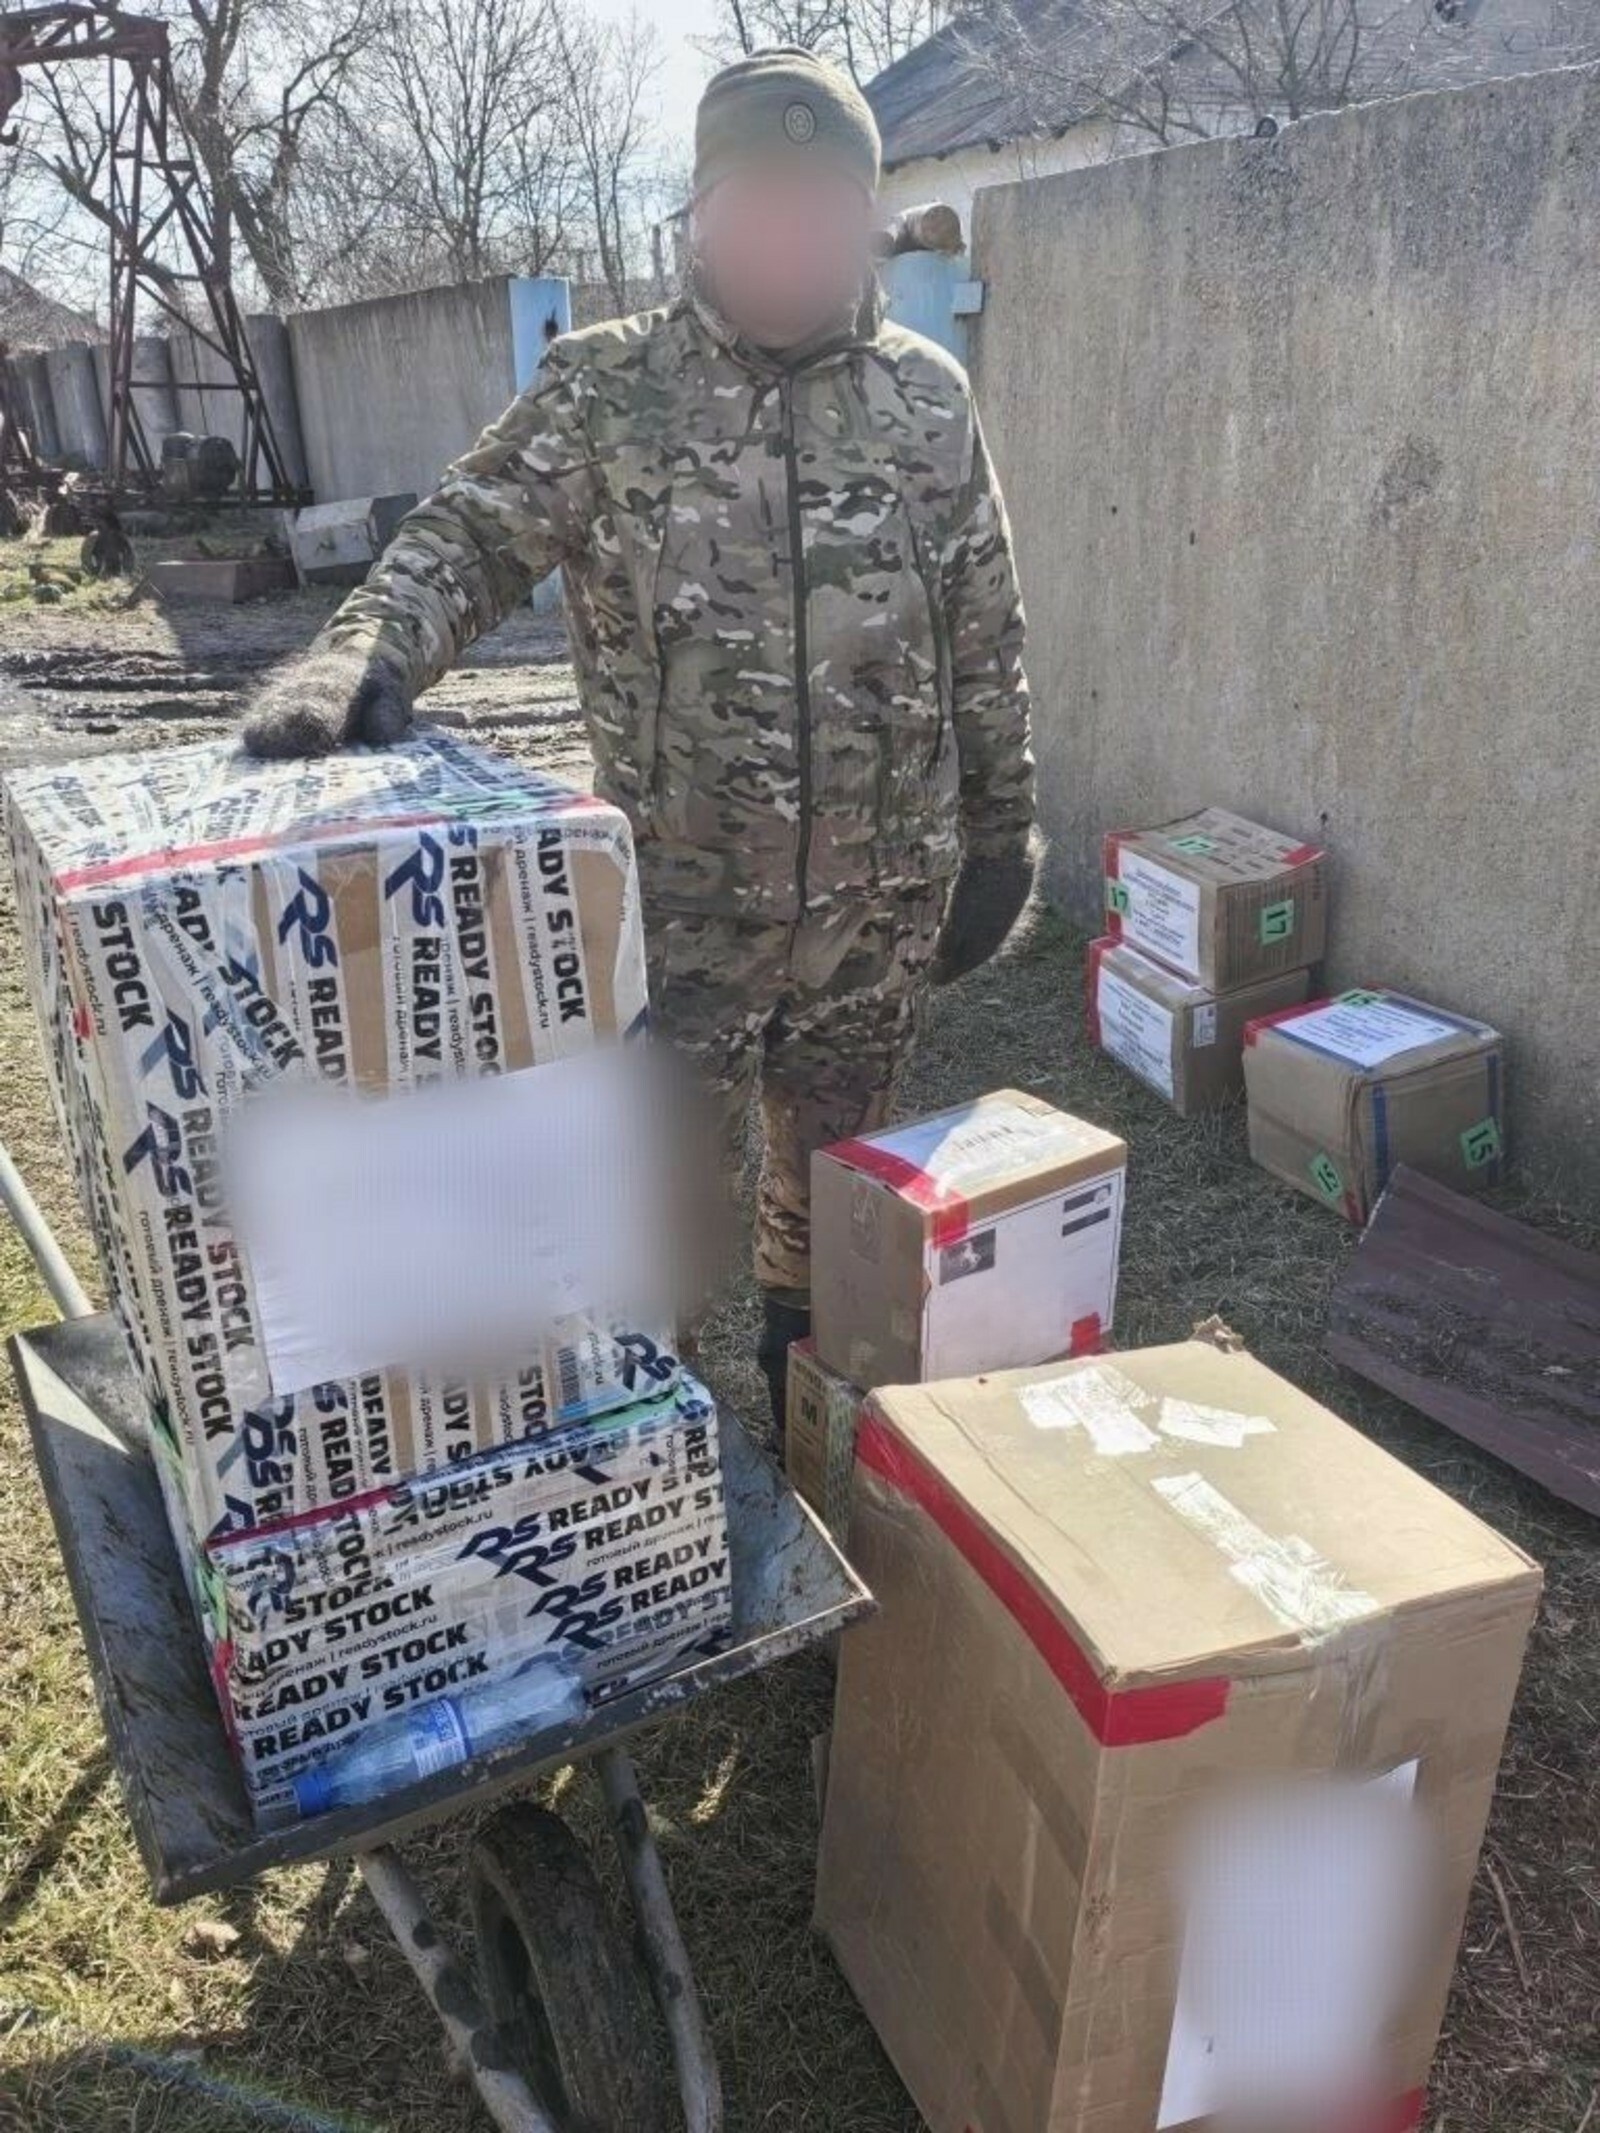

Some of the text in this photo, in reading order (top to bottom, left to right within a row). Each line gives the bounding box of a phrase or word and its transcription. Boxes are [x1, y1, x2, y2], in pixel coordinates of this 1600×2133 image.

[385, 830, 445, 928] RS
[450, 855, 491, 980] READY
[1265, 909, 1288, 935] 17
[92, 901, 155, 1032] STOCK
[412, 936, 442, 1061] READY
[526, 924, 550, 1029] readystock.ru
[307, 976, 348, 1080] READ
[1468, 1128, 1493, 1162] 15
[163, 1204, 213, 1321] READY
[186, 1332, 234, 1442] STOCK
[517, 1365, 549, 1437] STOC
[319, 1416, 357, 1500] READ
[494, 1530, 578, 1587] RS
[584, 1496, 684, 1551] READY
[548, 1478, 652, 1531] READY
[543, 1595, 624, 1651] RS
[631, 1557, 728, 1612] READY
[613, 1534, 713, 1590] READY
[324, 1584, 436, 1644] STOCK
[338, 1613, 438, 1658] readystock.ru
[360, 1621, 468, 1680] STOCK
[253, 1696, 372, 1761] READY
[383, 1651, 489, 1711] STOCK
